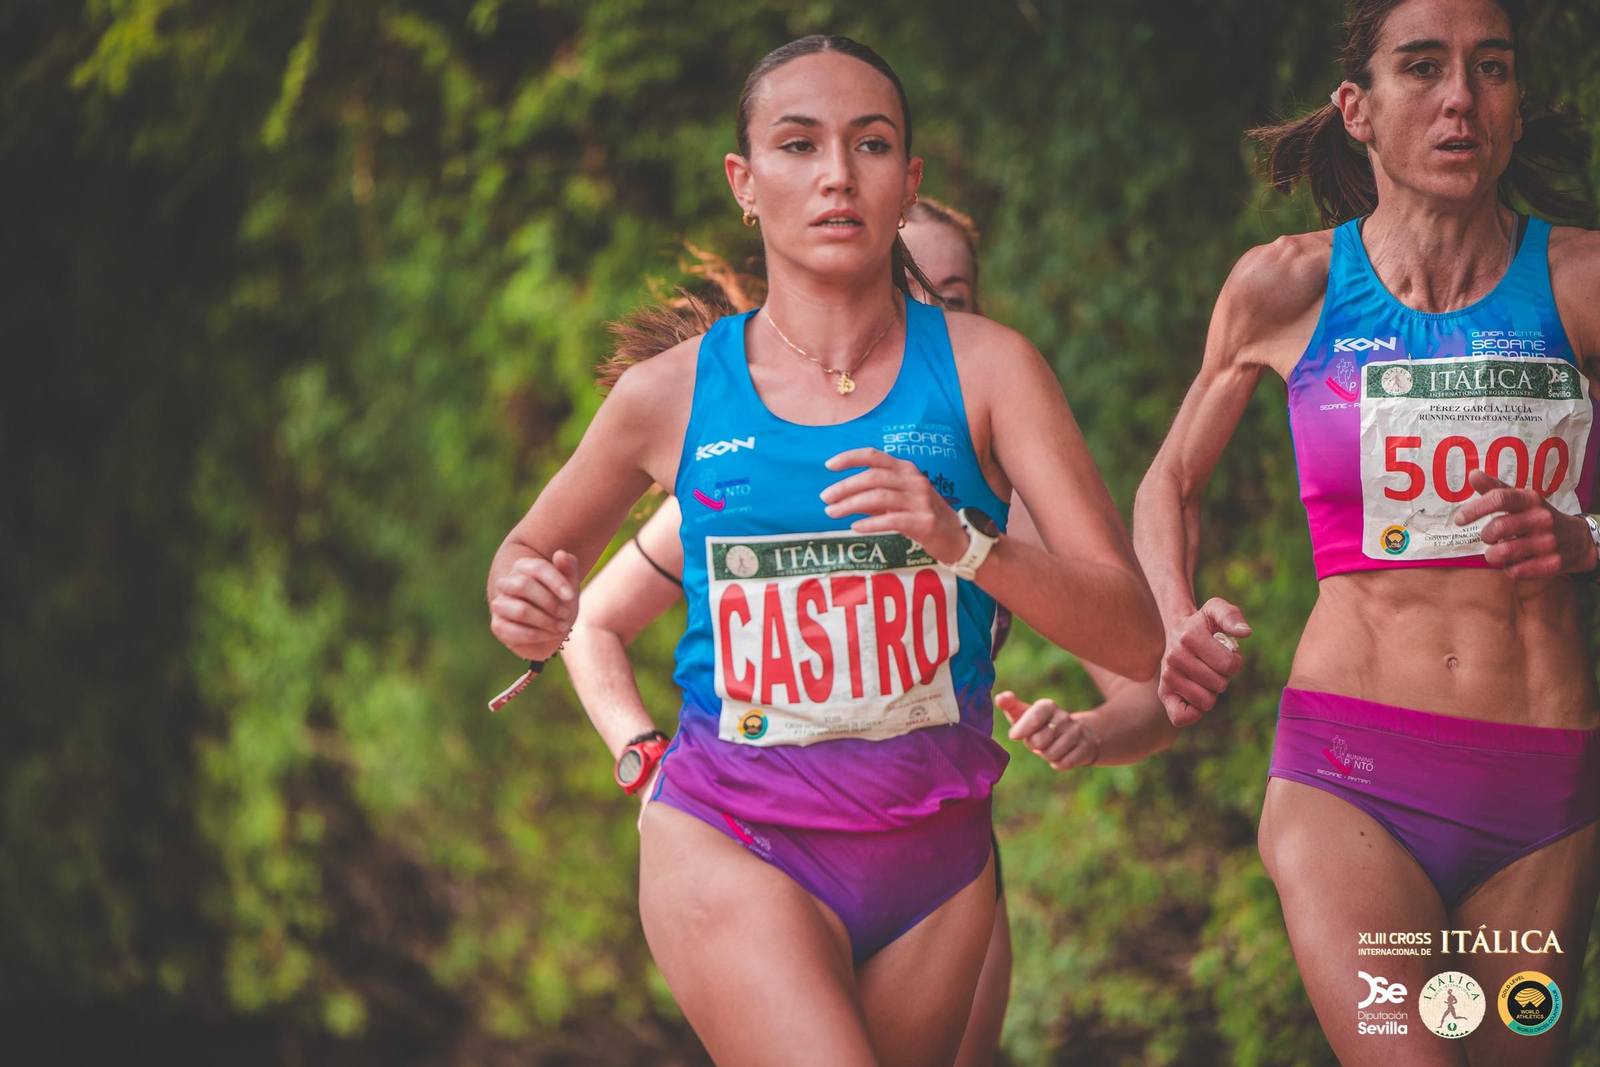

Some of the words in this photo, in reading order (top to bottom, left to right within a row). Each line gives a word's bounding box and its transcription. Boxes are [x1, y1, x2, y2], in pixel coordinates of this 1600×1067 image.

[1471, 339, 1546, 351] SEOANE
[1429, 365, 1533, 392] ITÁLICA
[1430, 390, 1481, 398] INTERNATIONAL
[1548, 390, 1571, 398] Sevilla
[1430, 403, 1460, 412] PÉREZ
[1463, 403, 1503, 413] GARCÍA,
[1505, 403, 1532, 413] LUCÍA
[1482, 414, 1543, 422] SEOANE-PAMPIN
[883, 431, 955, 446] SEOANE
[883, 444, 957, 459] PAMPIN
[1384, 435, 1569, 502] 5000
[1441, 531, 1481, 540] INTERNACION
[775, 541, 887, 571] ITÁLICA
[719, 568, 950, 705] CASTRO
